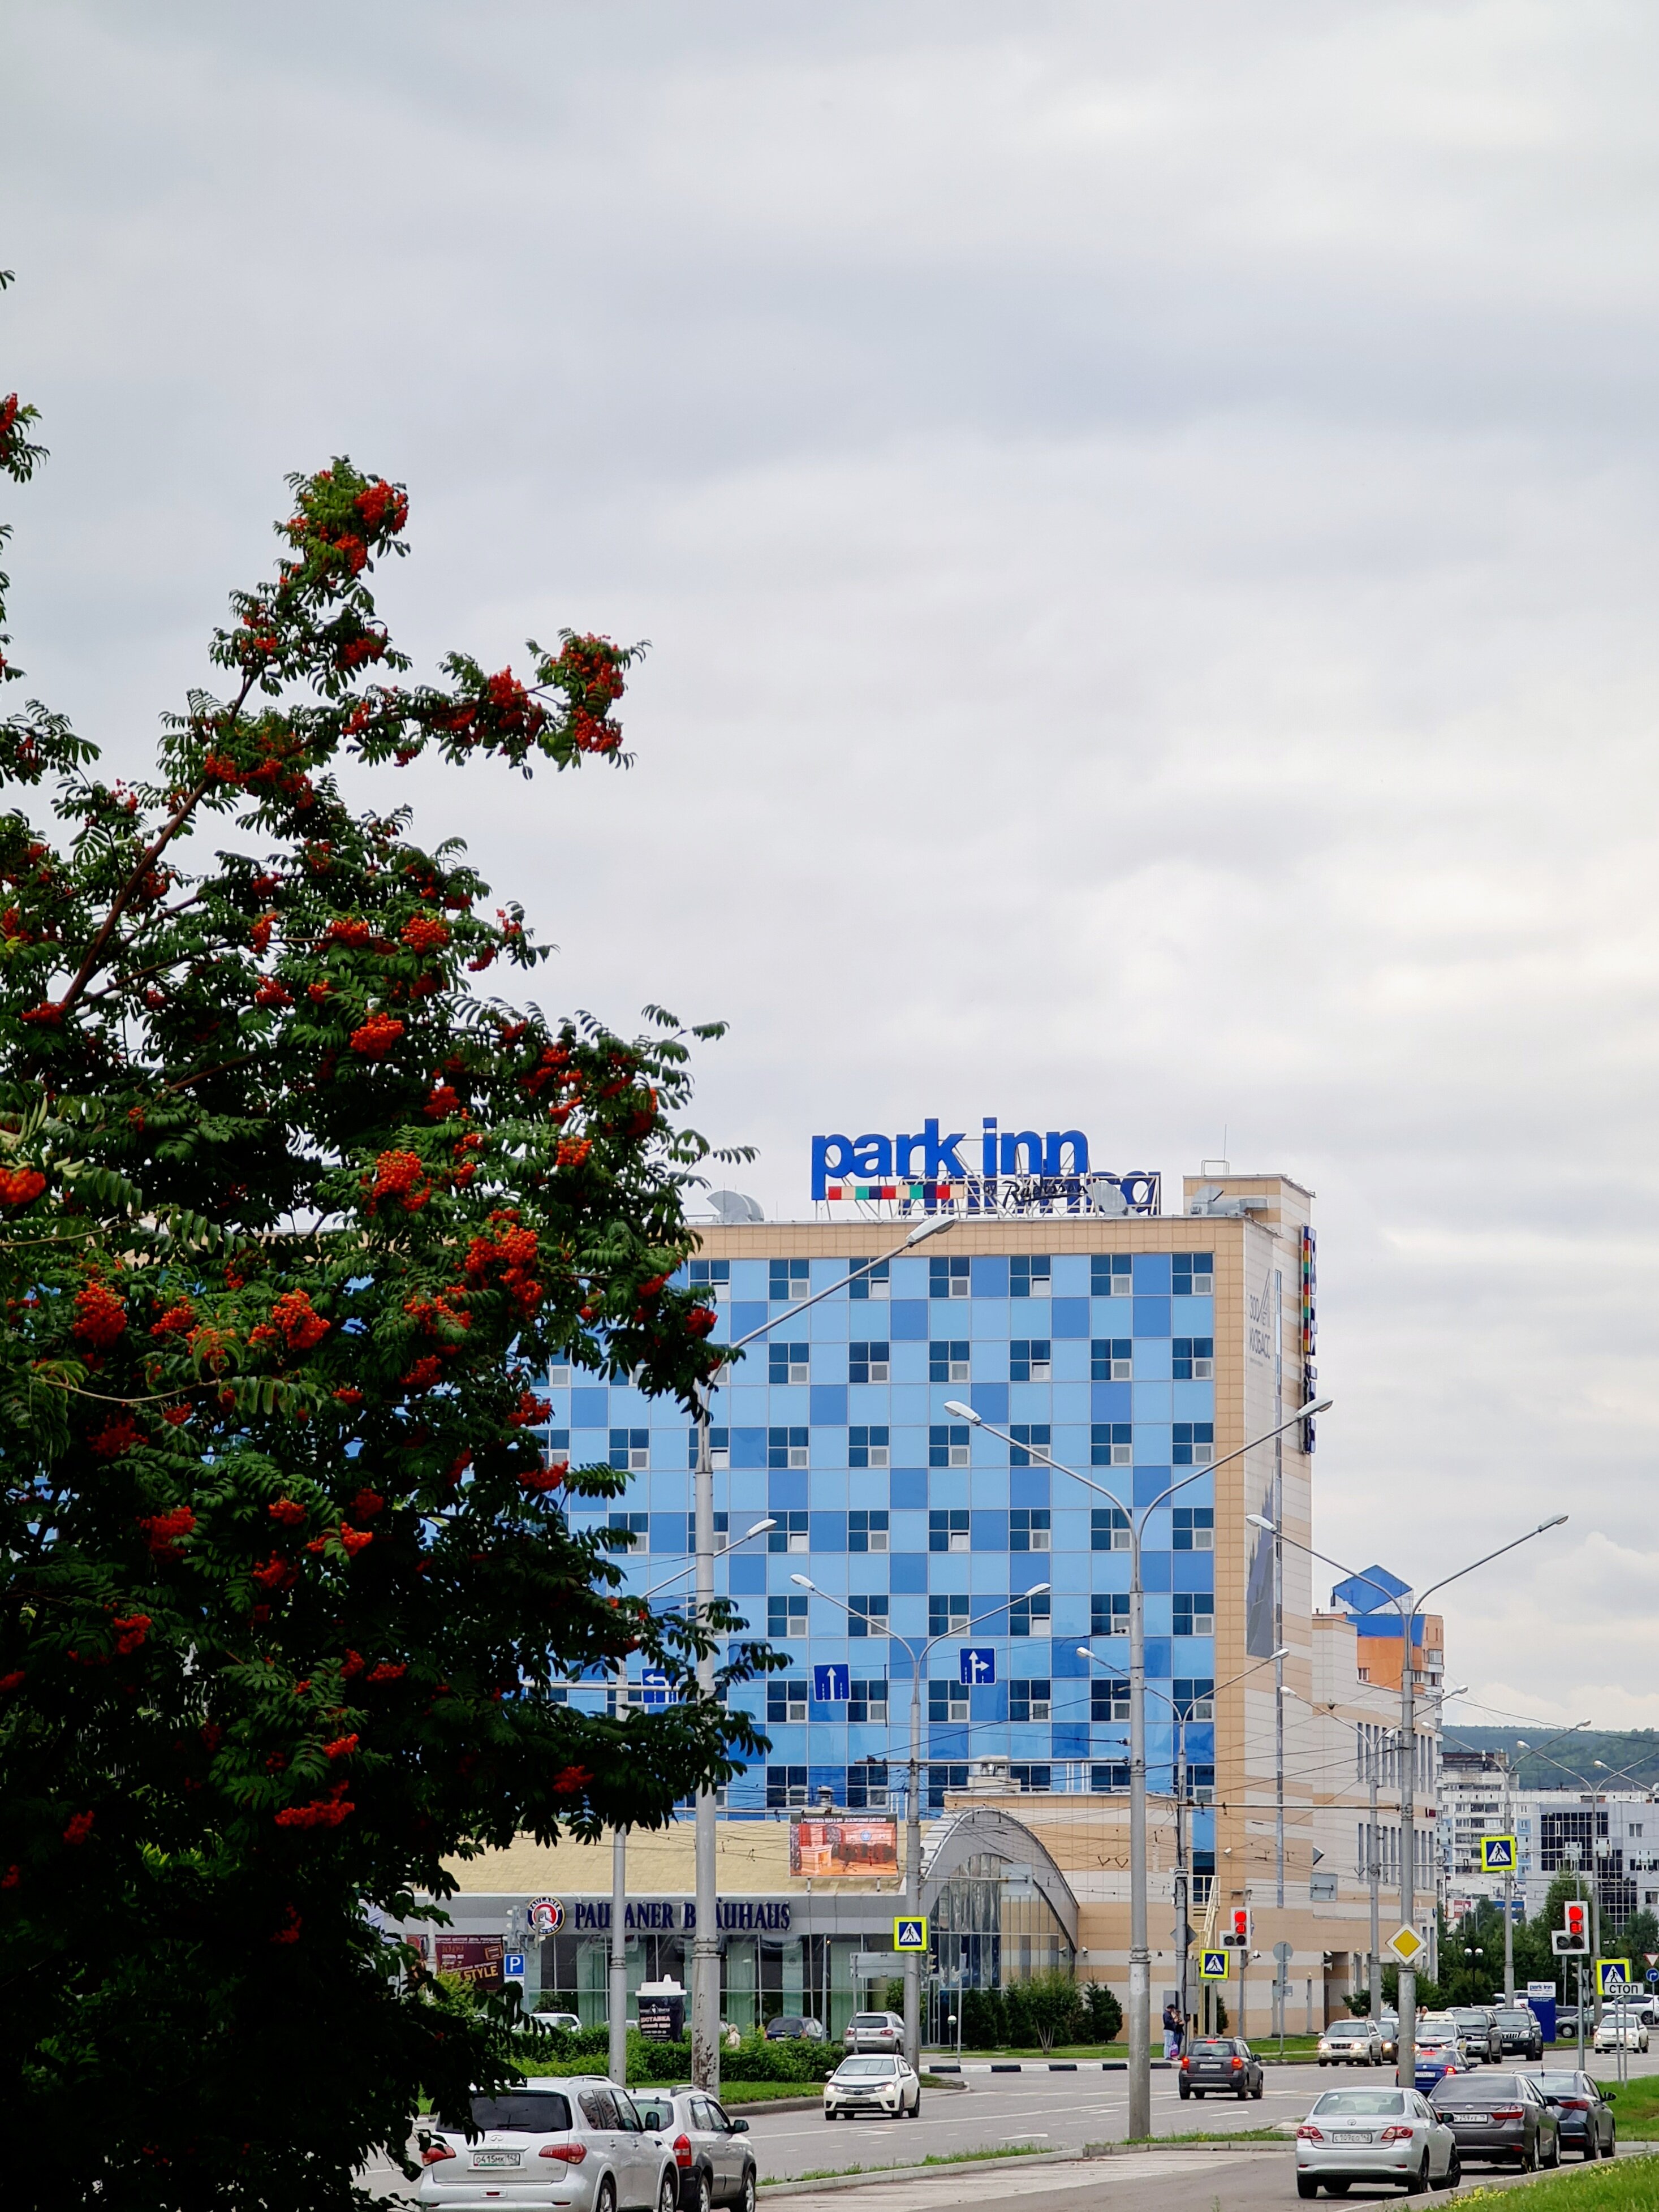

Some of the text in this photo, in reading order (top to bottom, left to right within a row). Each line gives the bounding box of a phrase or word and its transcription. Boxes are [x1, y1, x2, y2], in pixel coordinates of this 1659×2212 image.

[812, 1118, 966, 1200] park
[983, 1117, 1088, 1174] inn
[574, 1897, 791, 1929] PAUANER BÄUHAUS
[1609, 1985, 1638, 1994] СТОП
